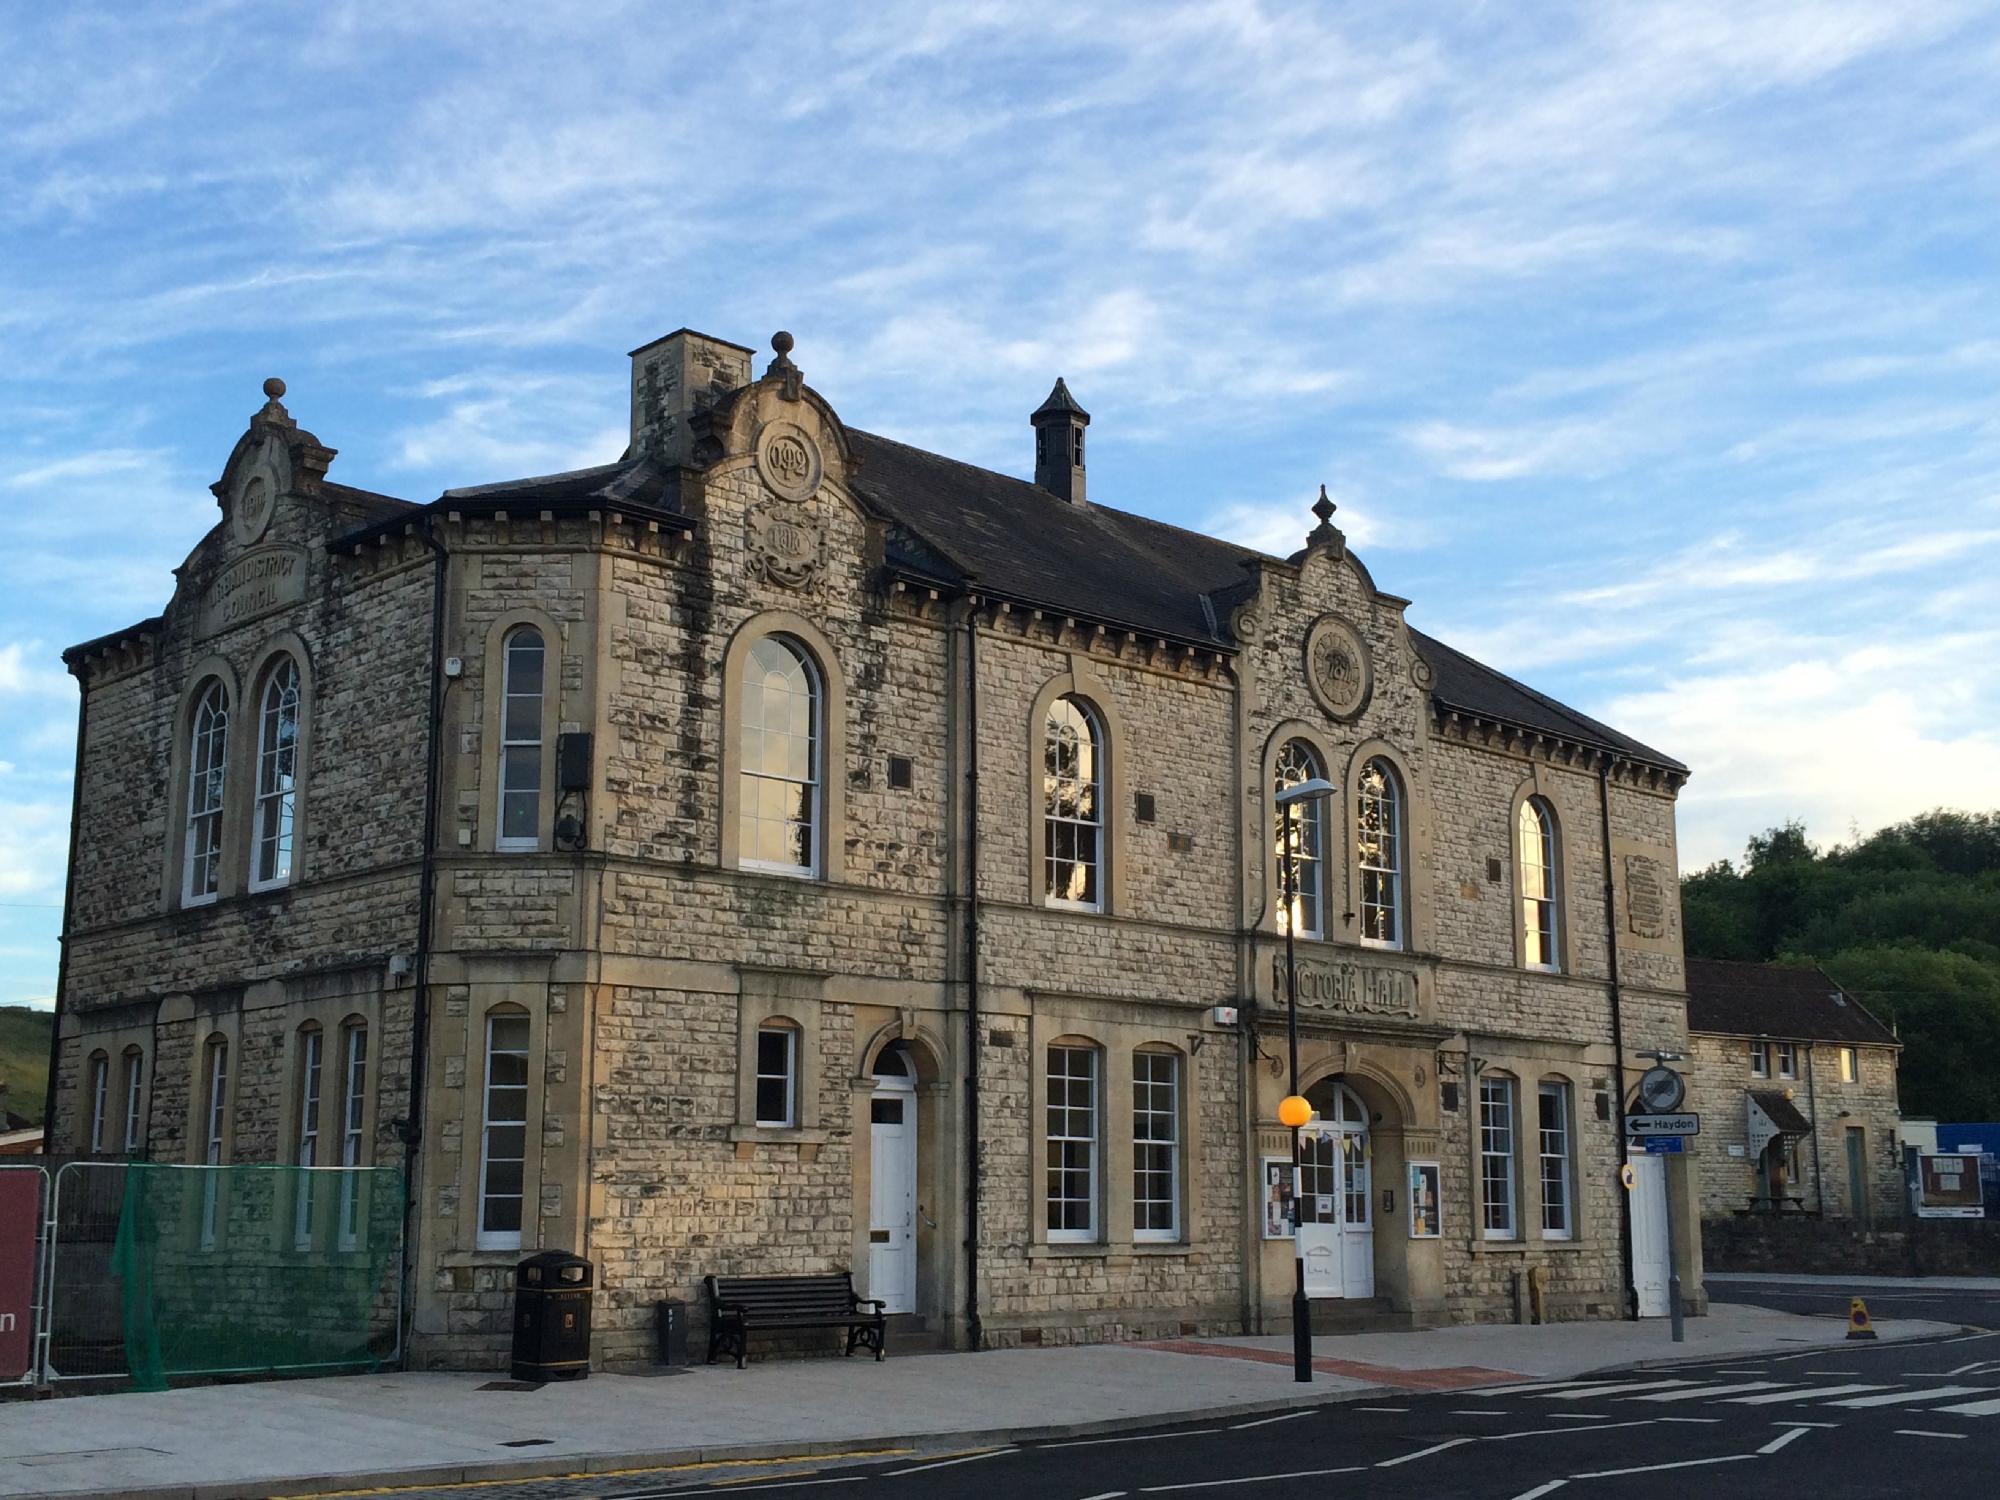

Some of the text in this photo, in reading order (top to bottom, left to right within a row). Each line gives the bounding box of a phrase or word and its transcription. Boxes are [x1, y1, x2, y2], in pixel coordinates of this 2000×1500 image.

[246, 553, 297, 583] DISTRICT
[223, 584, 278, 622] COUNCIL
[1362, 968, 1410, 1007] HALL
[1654, 1119, 1694, 1130] Haydon
